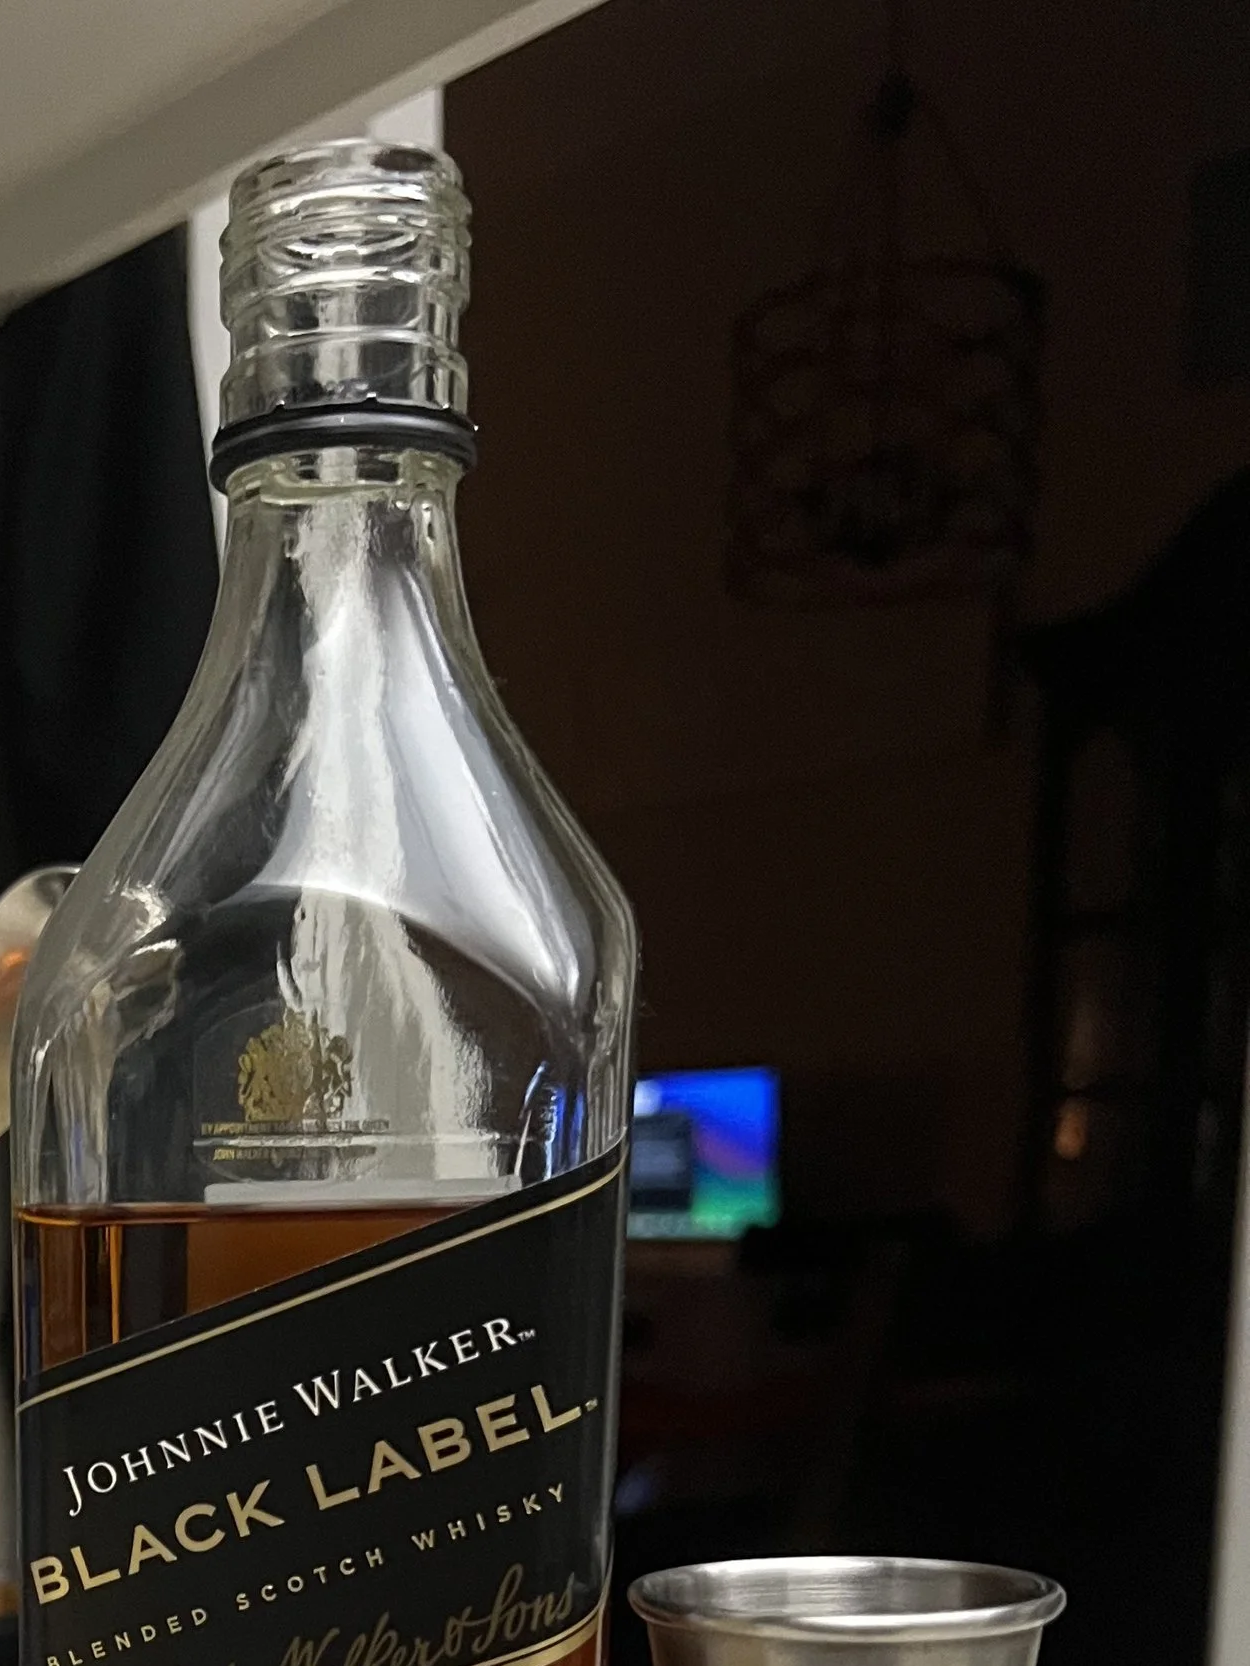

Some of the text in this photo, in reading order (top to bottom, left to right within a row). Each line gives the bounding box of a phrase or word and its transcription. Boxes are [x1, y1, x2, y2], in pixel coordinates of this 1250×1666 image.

[30, 1479, 285, 1604] BLACK
[305, 1384, 583, 1511] LABEL
[63, 1400, 284, 1516] JOHNNIE
[293, 1316, 519, 1417] WALKER
[236, 1548, 384, 1611] SCOTCH
[412, 1483, 565, 1551] WHISKY
[472, 1563, 576, 1655] Sons
